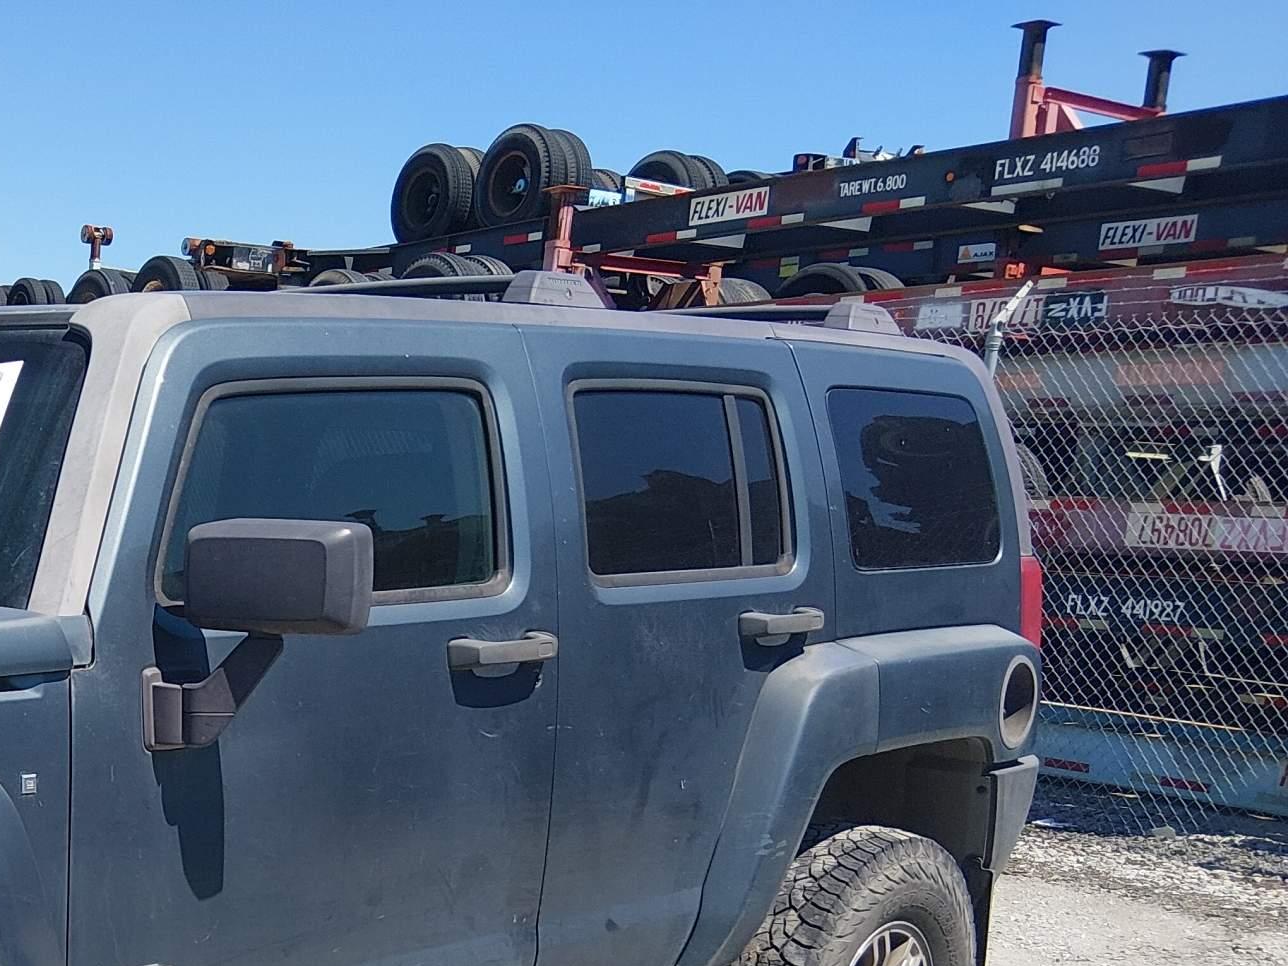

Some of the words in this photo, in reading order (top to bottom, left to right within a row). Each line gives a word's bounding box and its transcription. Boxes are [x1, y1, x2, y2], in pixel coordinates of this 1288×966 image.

[994, 155, 1035, 180] FLXZ
[1040, 145, 1100, 173] 414688
[690, 190, 768, 222] FLEXI-VAN
[1101, 219, 1195, 247] FLEXI-VAN
[1048, 295, 1108, 318] FVXZ
[1066, 594, 1110, 617] FLXZ
